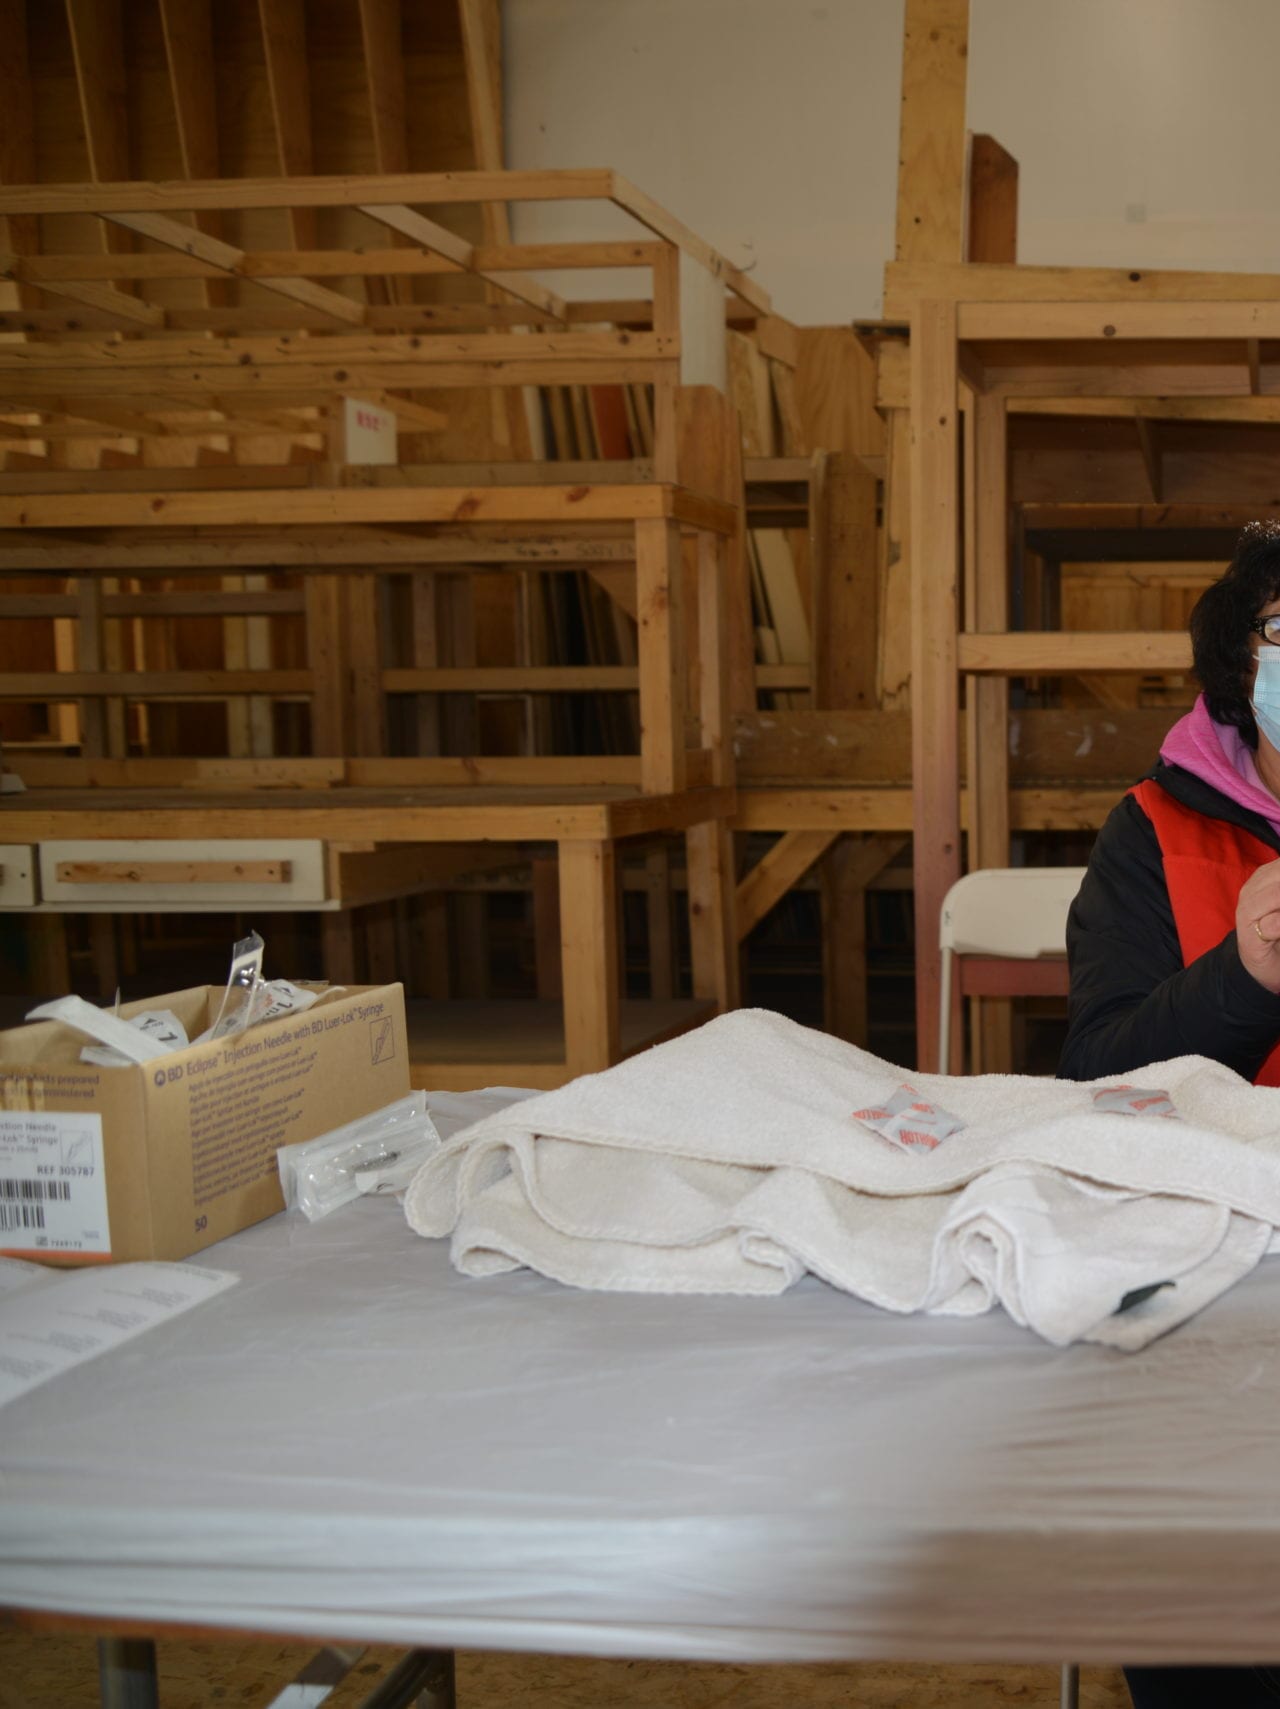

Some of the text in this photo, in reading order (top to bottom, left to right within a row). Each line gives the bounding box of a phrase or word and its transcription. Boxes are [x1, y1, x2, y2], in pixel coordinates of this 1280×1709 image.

[167, 1065, 184, 1081] BD
[224, 1042, 262, 1065] Injection
[264, 1031, 292, 1049] Needle
[294, 1022, 311, 1040] with
[312, 1019, 323, 1035] BD
[358, 1003, 384, 1021] Syringe
[58, 1073, 100, 1086] prepared
[37, 1165, 55, 1175] REF
[194, 1214, 208, 1232] 50
